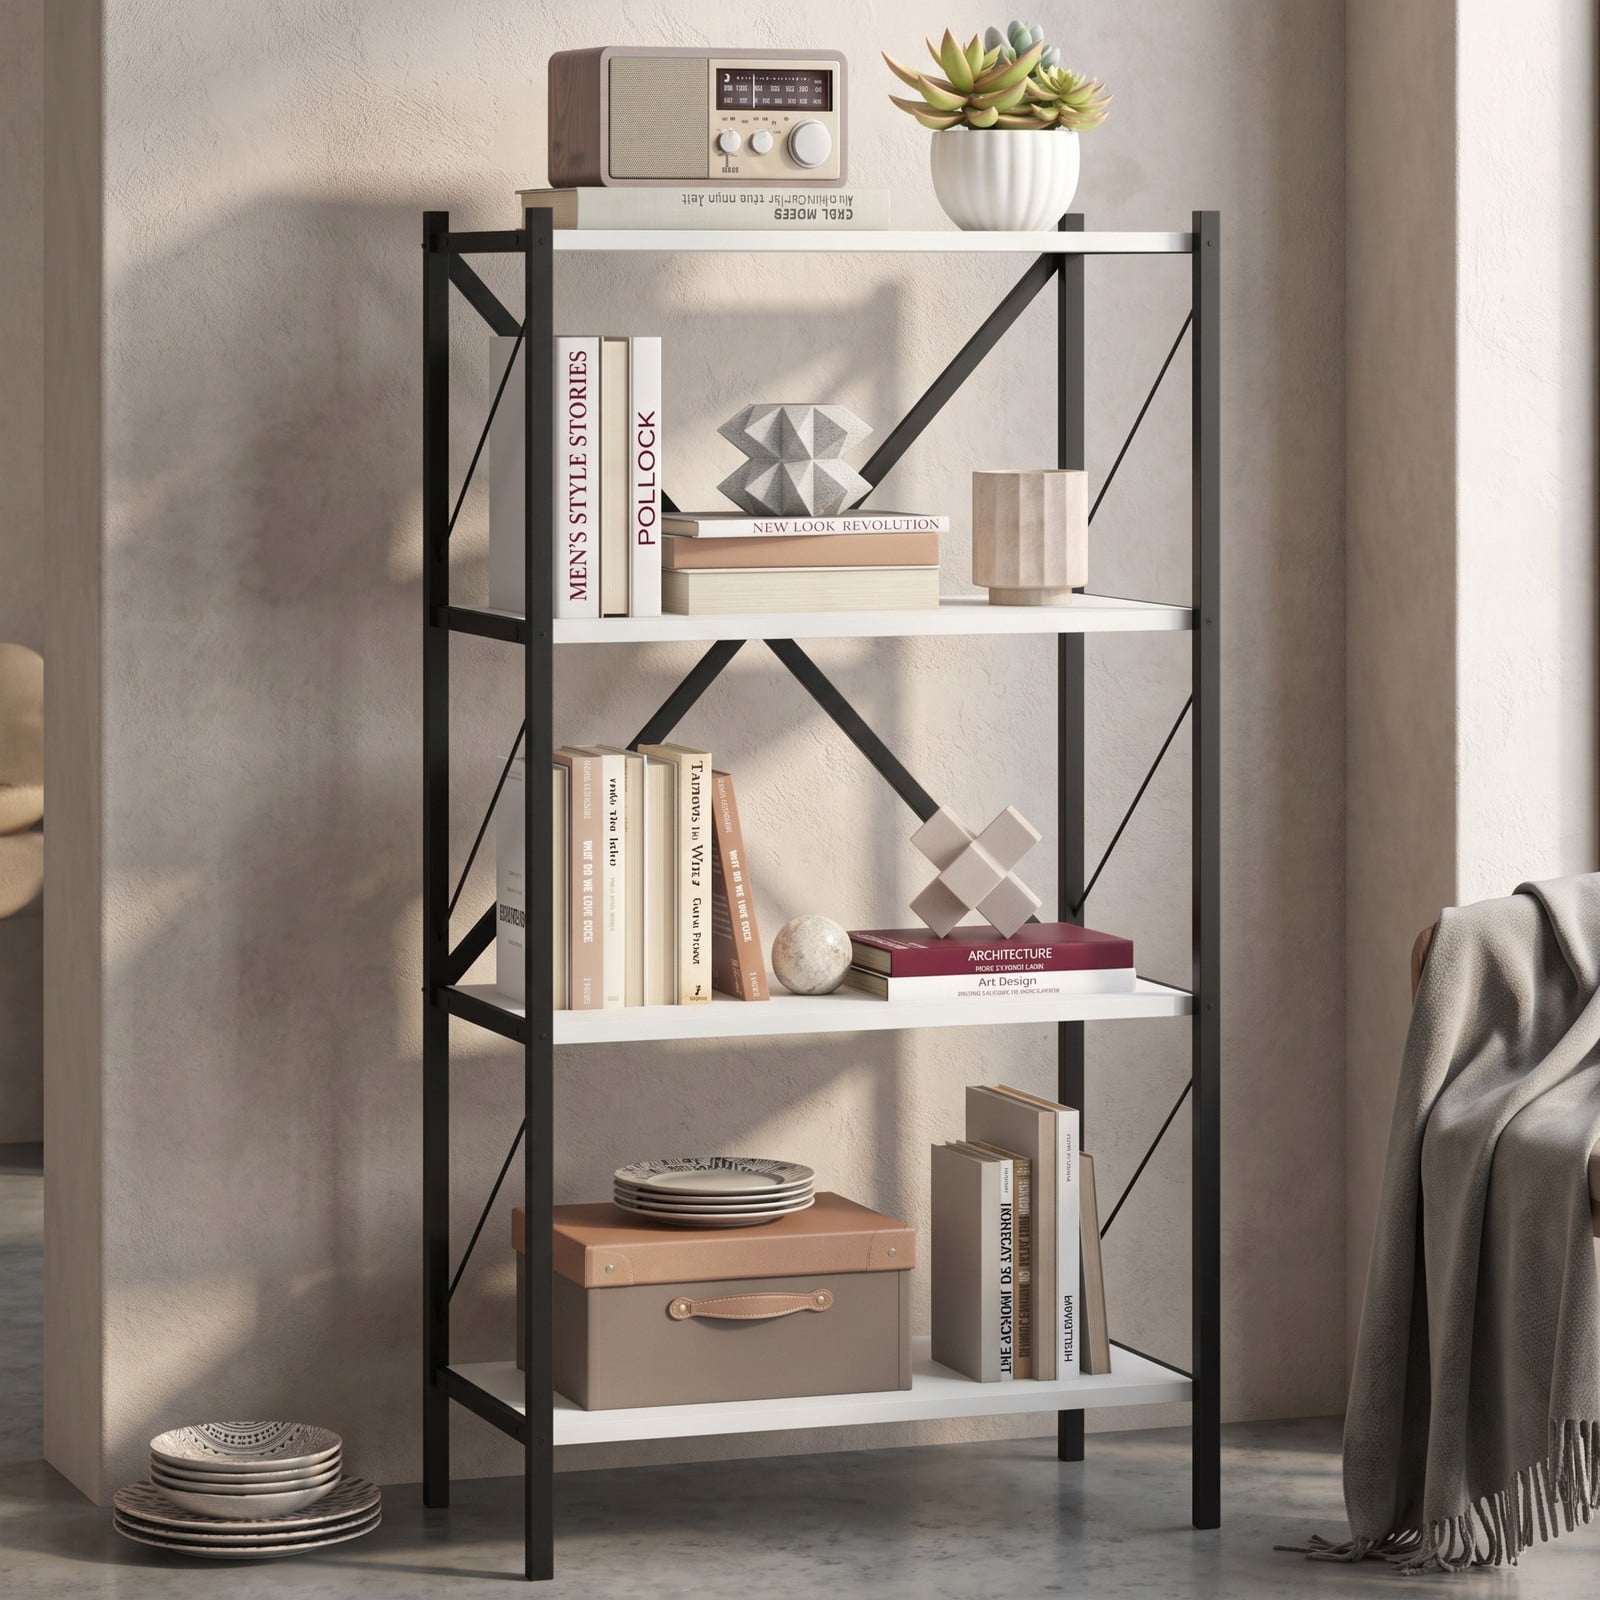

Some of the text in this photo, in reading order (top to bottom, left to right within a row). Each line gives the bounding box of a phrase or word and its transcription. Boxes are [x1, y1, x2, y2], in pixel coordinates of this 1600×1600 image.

[568, 350, 588, 601] MEN'S STYLE STORIES
[637, 410, 656, 546] POLLOCK
[753, 518, 940, 534] NEW LOOK REVOLUTION
[968, 948, 1053, 961] ARCHITECTURE
[978, 976, 1037, 988] Art Design
